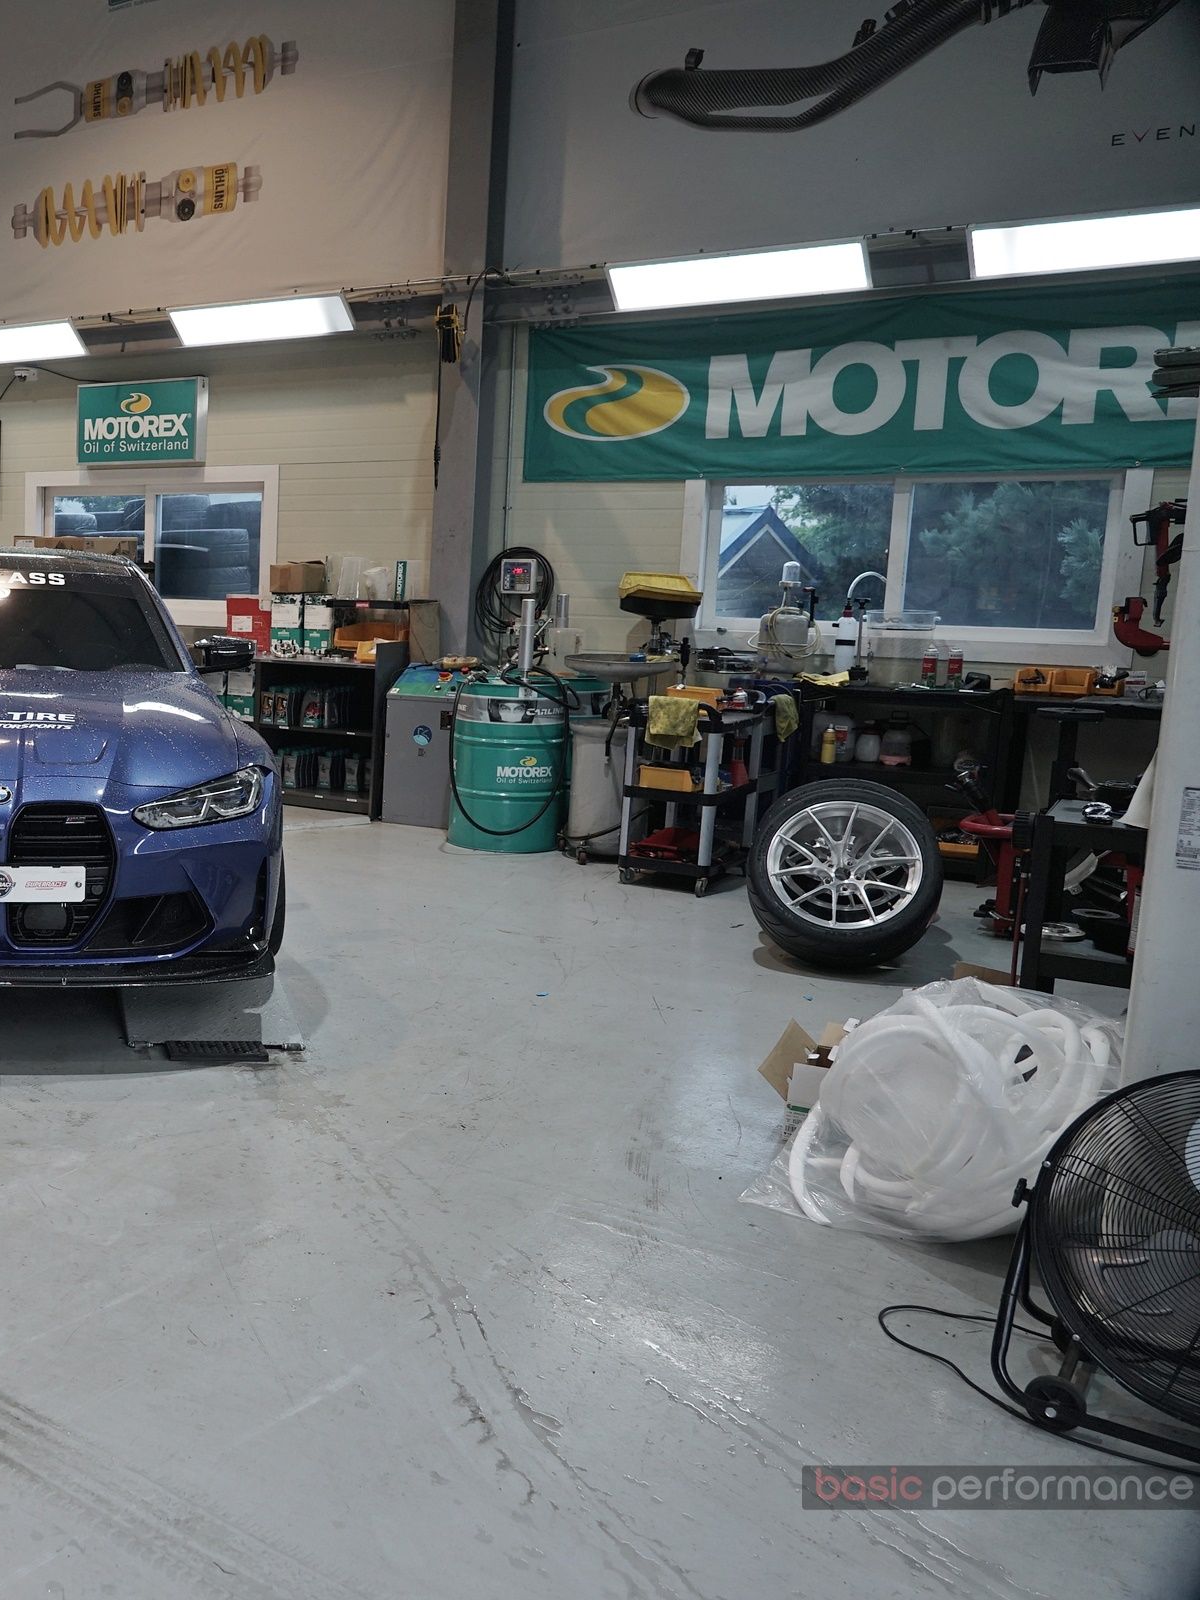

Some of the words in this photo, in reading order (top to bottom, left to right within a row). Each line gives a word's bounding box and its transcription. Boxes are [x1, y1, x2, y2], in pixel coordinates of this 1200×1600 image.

[84, 413, 189, 441] MOTOREX
[84, 442, 99, 453] Oil
[103, 441, 116, 453] of
[119, 438, 189, 452] Switzerland
[8, 711, 76, 723] TIRE
[496, 766, 552, 778] MOTOREX
[496, 777, 506, 785] Oil
